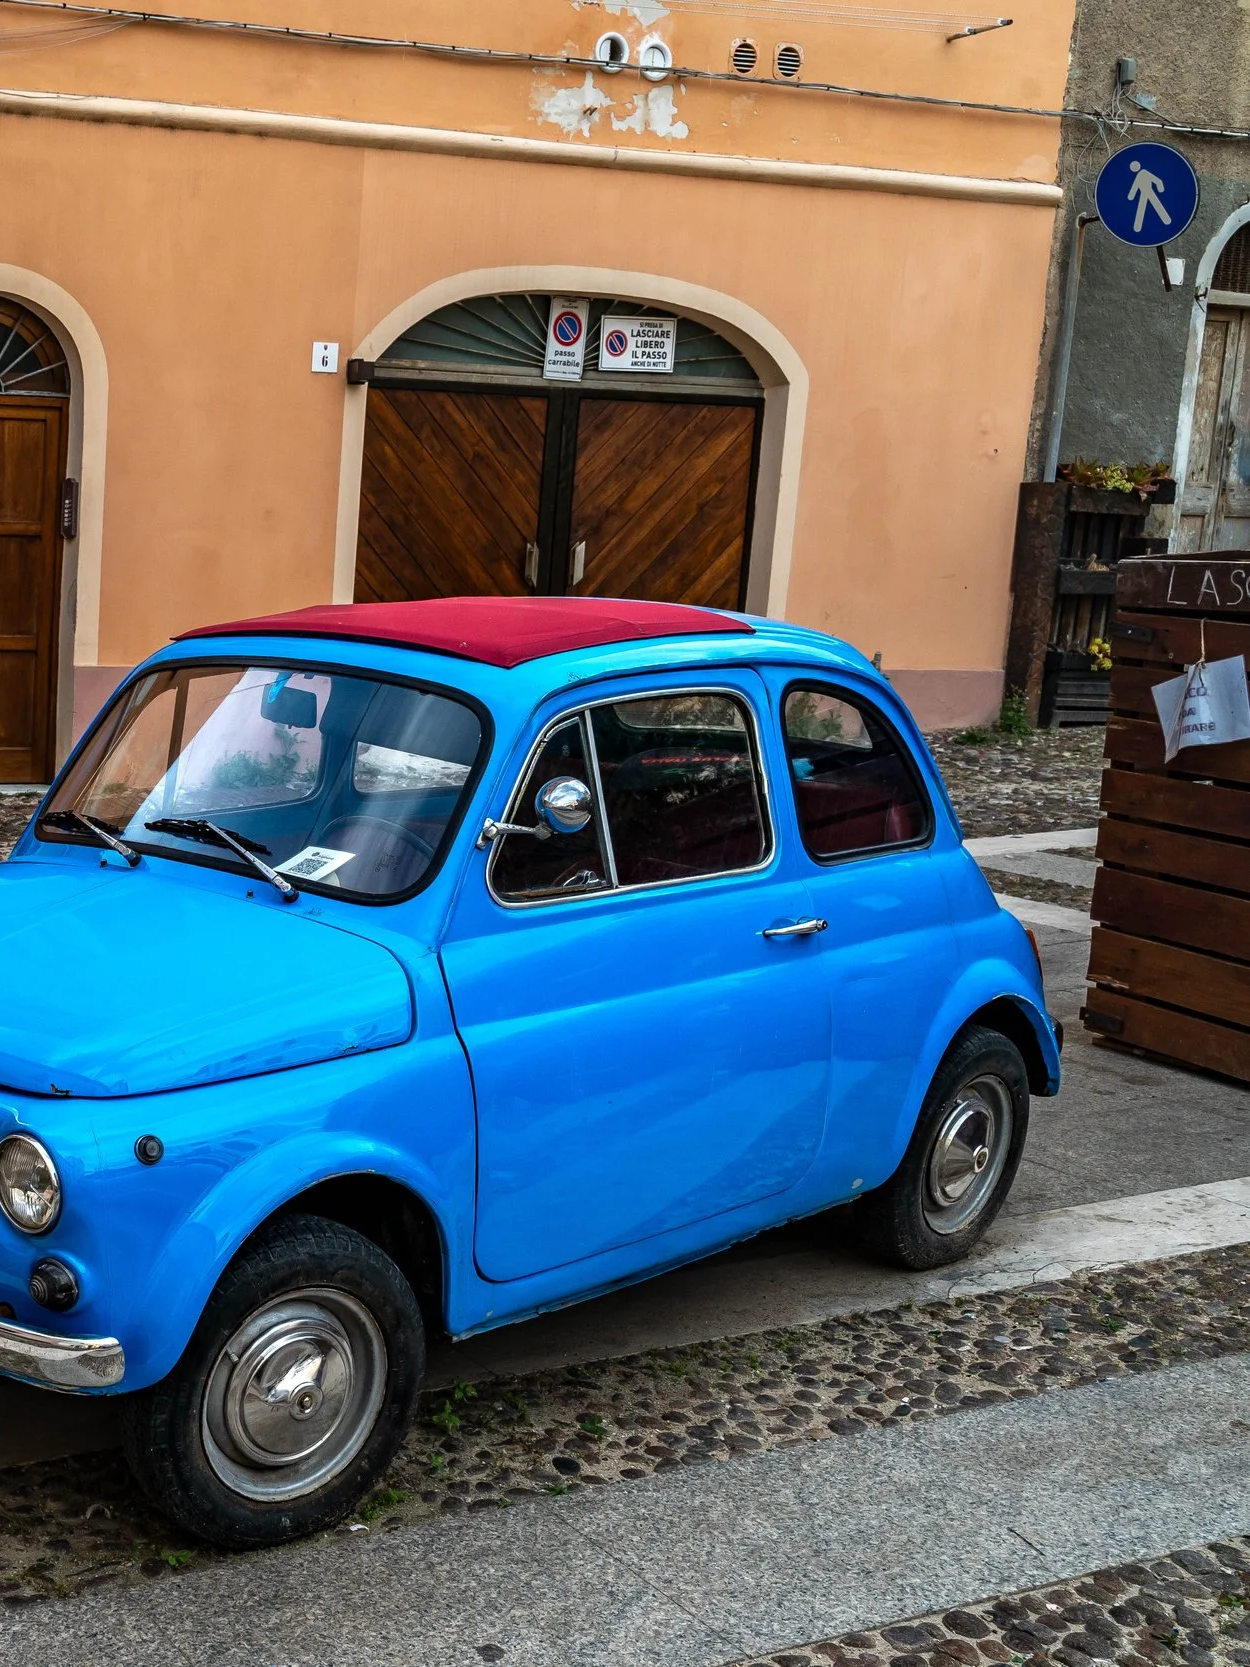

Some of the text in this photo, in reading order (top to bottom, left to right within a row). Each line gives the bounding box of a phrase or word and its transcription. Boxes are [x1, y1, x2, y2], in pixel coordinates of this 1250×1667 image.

[630, 328, 671, 339] LASCIARE
[635, 340, 665, 349] LIBERO
[554, 349, 576, 358] passo
[631, 350, 667, 360] IL PASSO
[321, 354, 328, 368] 6
[547, 358, 580, 368] carrabile
[1166, 565, 1250, 606] LAS
